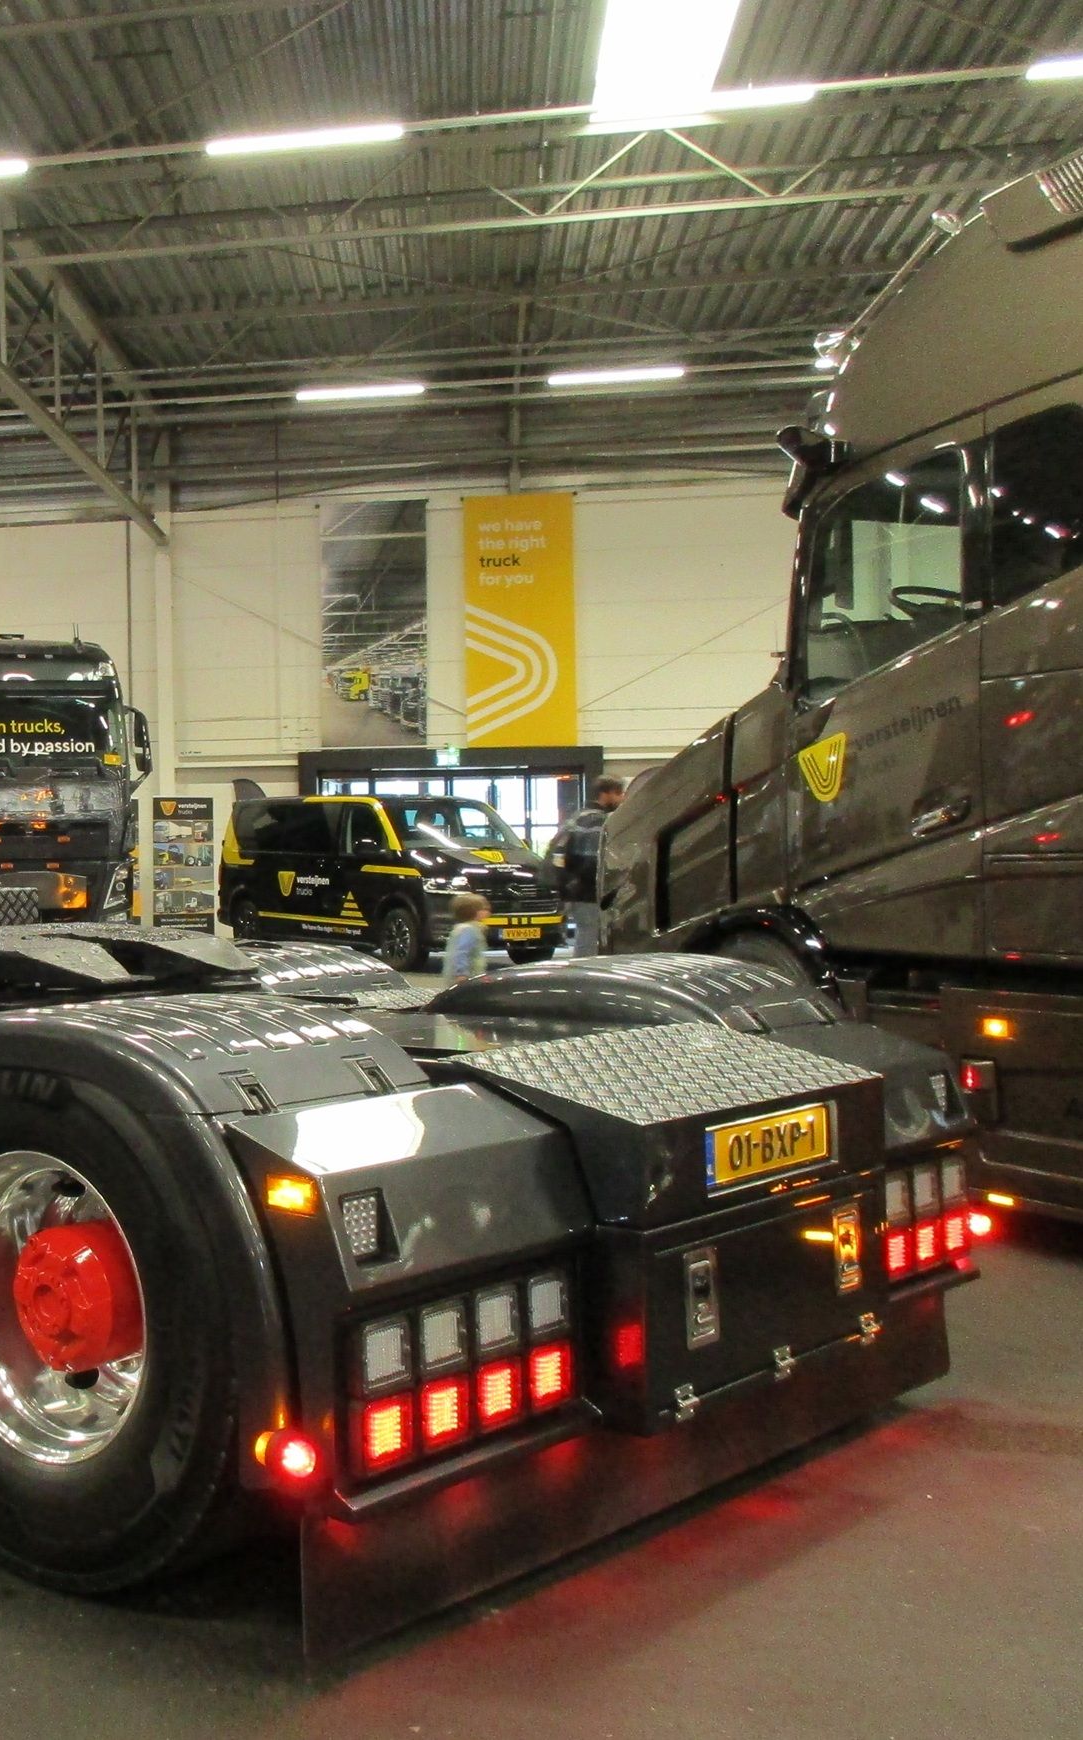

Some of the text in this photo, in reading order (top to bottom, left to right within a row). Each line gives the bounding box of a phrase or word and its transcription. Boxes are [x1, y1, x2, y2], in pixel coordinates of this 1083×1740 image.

[479, 519, 542, 532] we have
[479, 535, 547, 552] the right
[479, 553, 521, 567] truck
[479, 572, 534, 588] for you
[9, 719, 65, 735] trucks,
[10, 739, 31, 757] by
[34, 739, 95, 756] passion
[728, 1114, 816, 1171] 01-BXP-1
